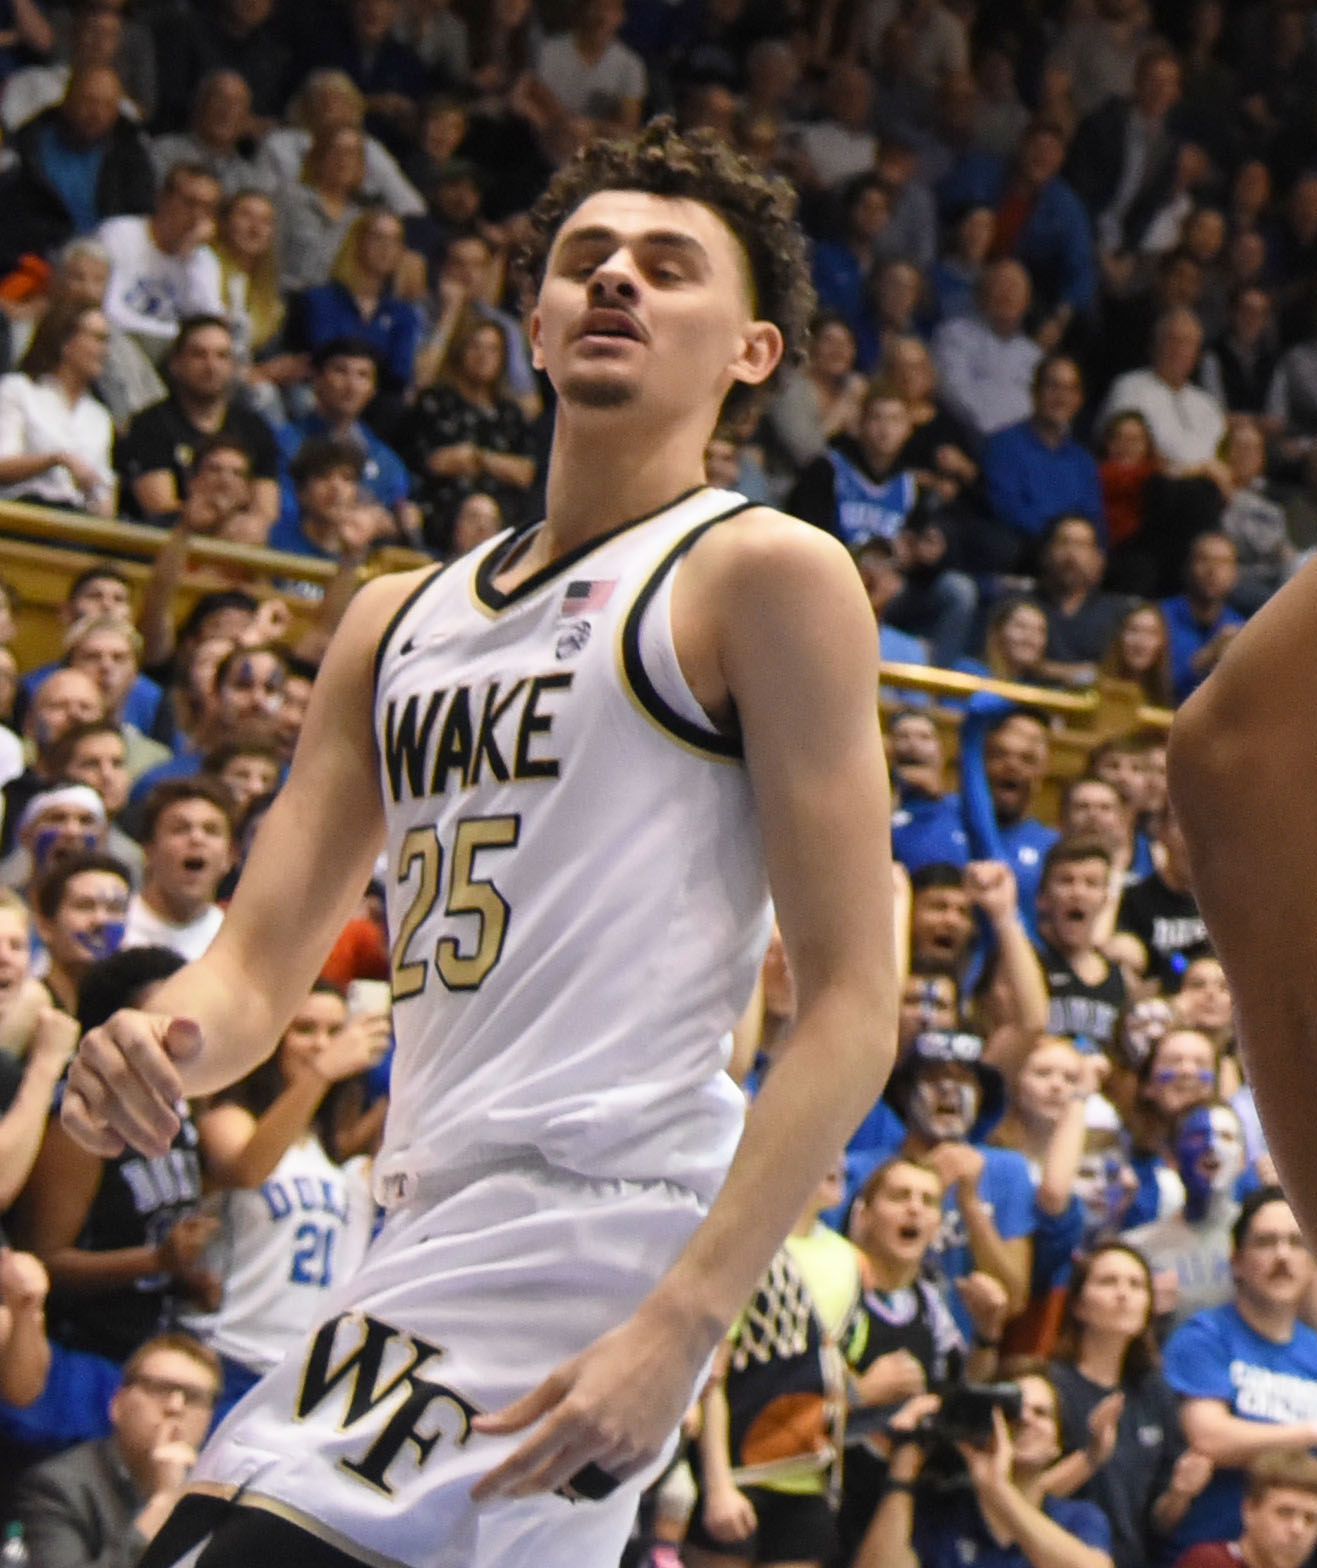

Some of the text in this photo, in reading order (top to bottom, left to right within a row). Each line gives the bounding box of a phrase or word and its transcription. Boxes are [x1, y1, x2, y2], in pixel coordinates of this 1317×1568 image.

[384, 671, 575, 804] WAKE
[391, 813, 521, 1003] 25
[290, 1221, 335, 1288] 21
[293, 1310, 482, 1502] WF
